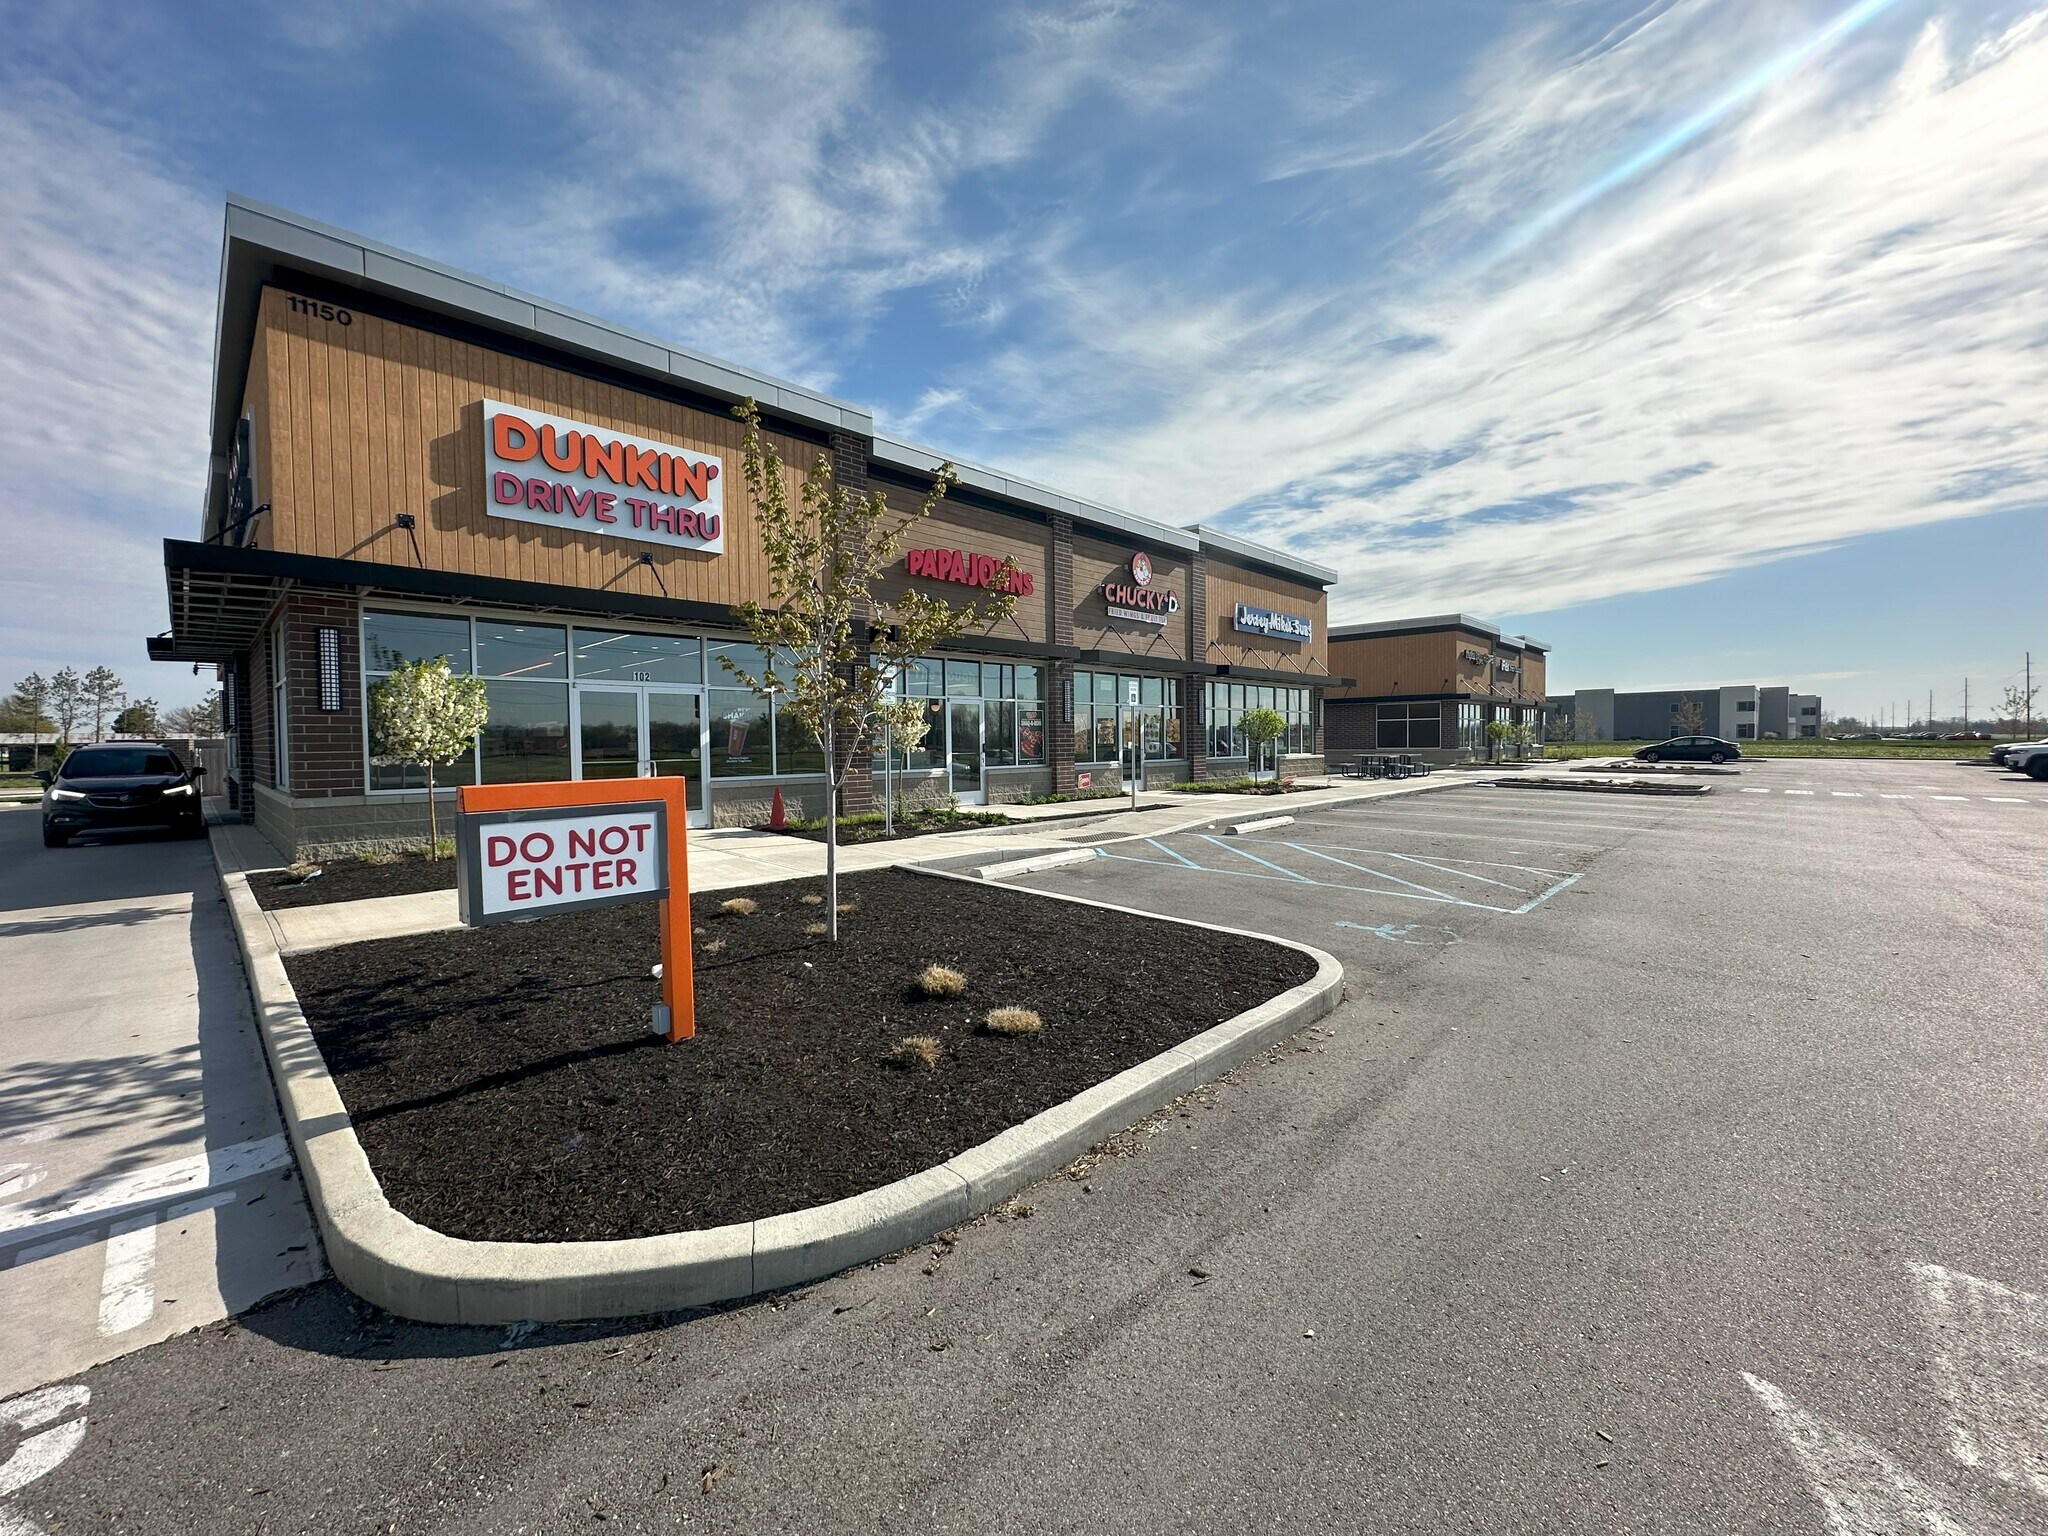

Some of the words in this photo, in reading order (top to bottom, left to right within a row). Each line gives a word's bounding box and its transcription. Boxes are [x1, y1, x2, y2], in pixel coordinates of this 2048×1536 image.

[287, 296, 352, 326] 11150
[493, 413, 719, 502] DUNKIN'
[494, 471, 617, 523] DRIVE
[625, 496, 720, 540] THRU
[908, 549, 967, 584] PAPA
[634, 672, 650, 682] 102
[487, 832, 555, 868] DO
[568, 823, 652, 860] NOT
[507, 858, 638, 902] ENTER
